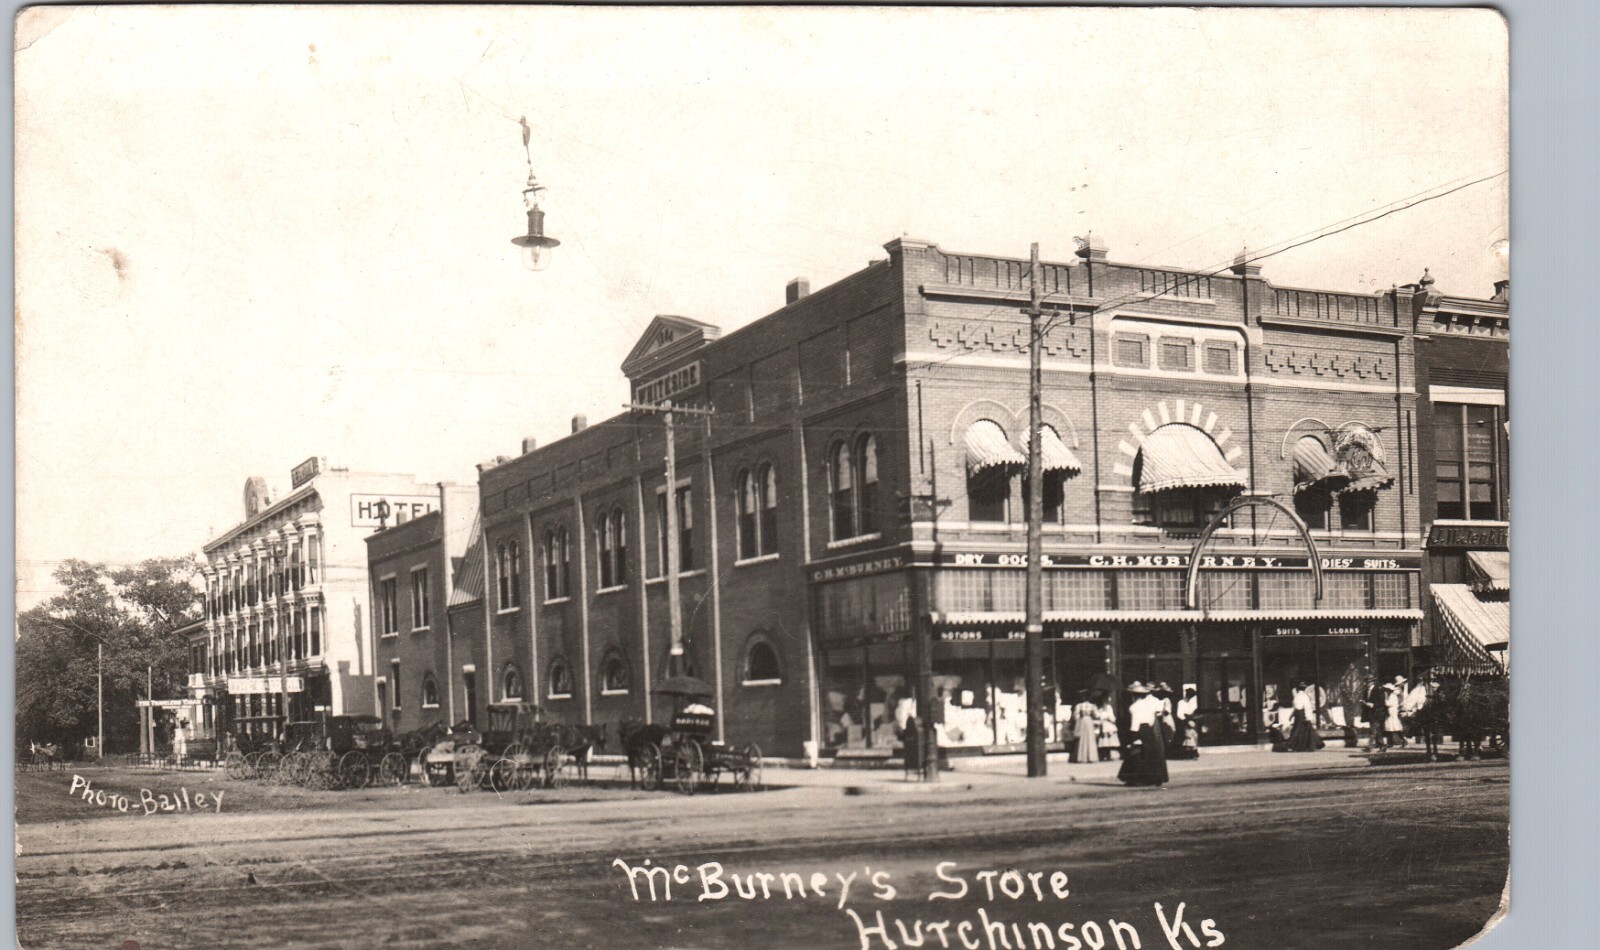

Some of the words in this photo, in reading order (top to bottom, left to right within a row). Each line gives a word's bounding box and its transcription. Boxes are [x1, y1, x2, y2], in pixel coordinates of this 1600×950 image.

[955, 553, 984, 566] DRY
[998, 554, 1054, 566] GOOS.
[1308, 558, 1353, 569] DIES'
[1364, 559, 1400, 569] SUITS.
[1063, 630, 1100, 639] HOSIERY
